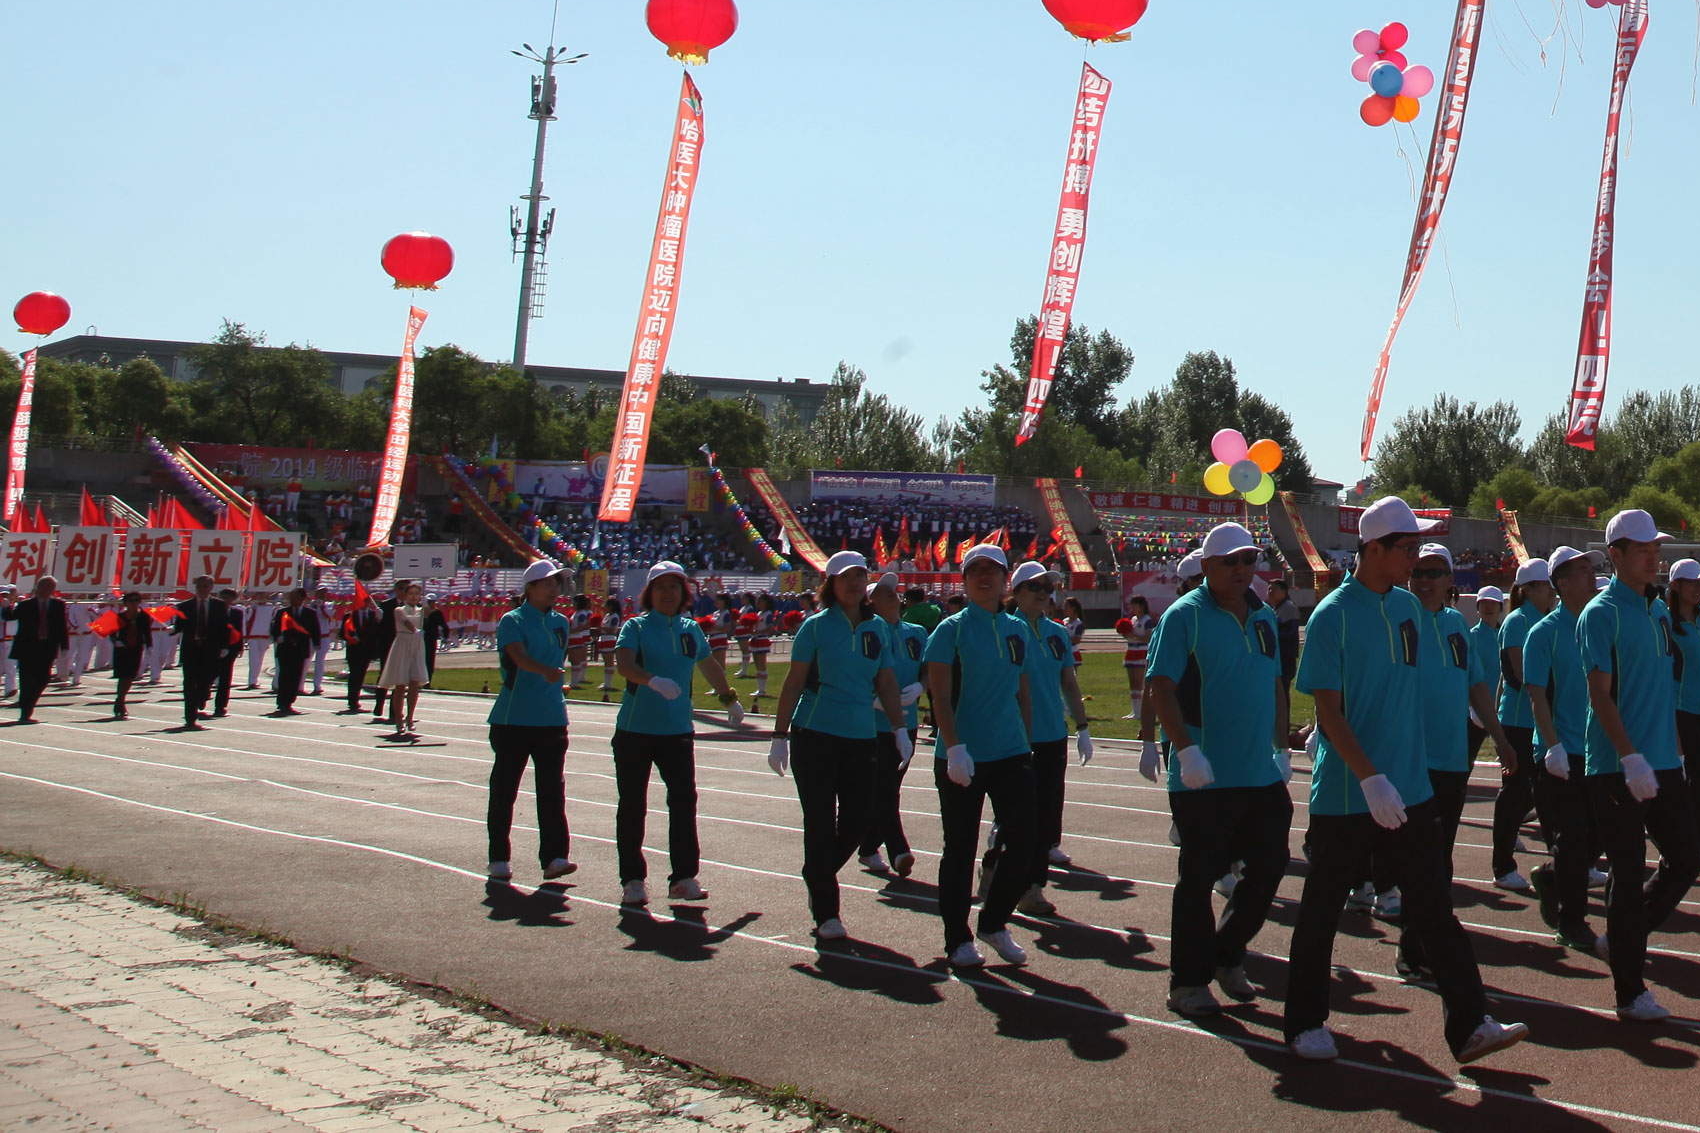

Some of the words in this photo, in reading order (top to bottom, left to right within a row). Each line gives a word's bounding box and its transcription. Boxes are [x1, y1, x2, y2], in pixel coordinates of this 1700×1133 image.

[607, 117, 699, 512] 哈医大肿瘤医院迈向健康中国新征程
[270, 457, 316, 478] 2014
[906, 478, 945, 491] 全力以赴
[1133, 494, 1161, 509] 仁德
[1170, 497, 1199, 512] 精进
[1208, 499, 1237, 514] 创新
